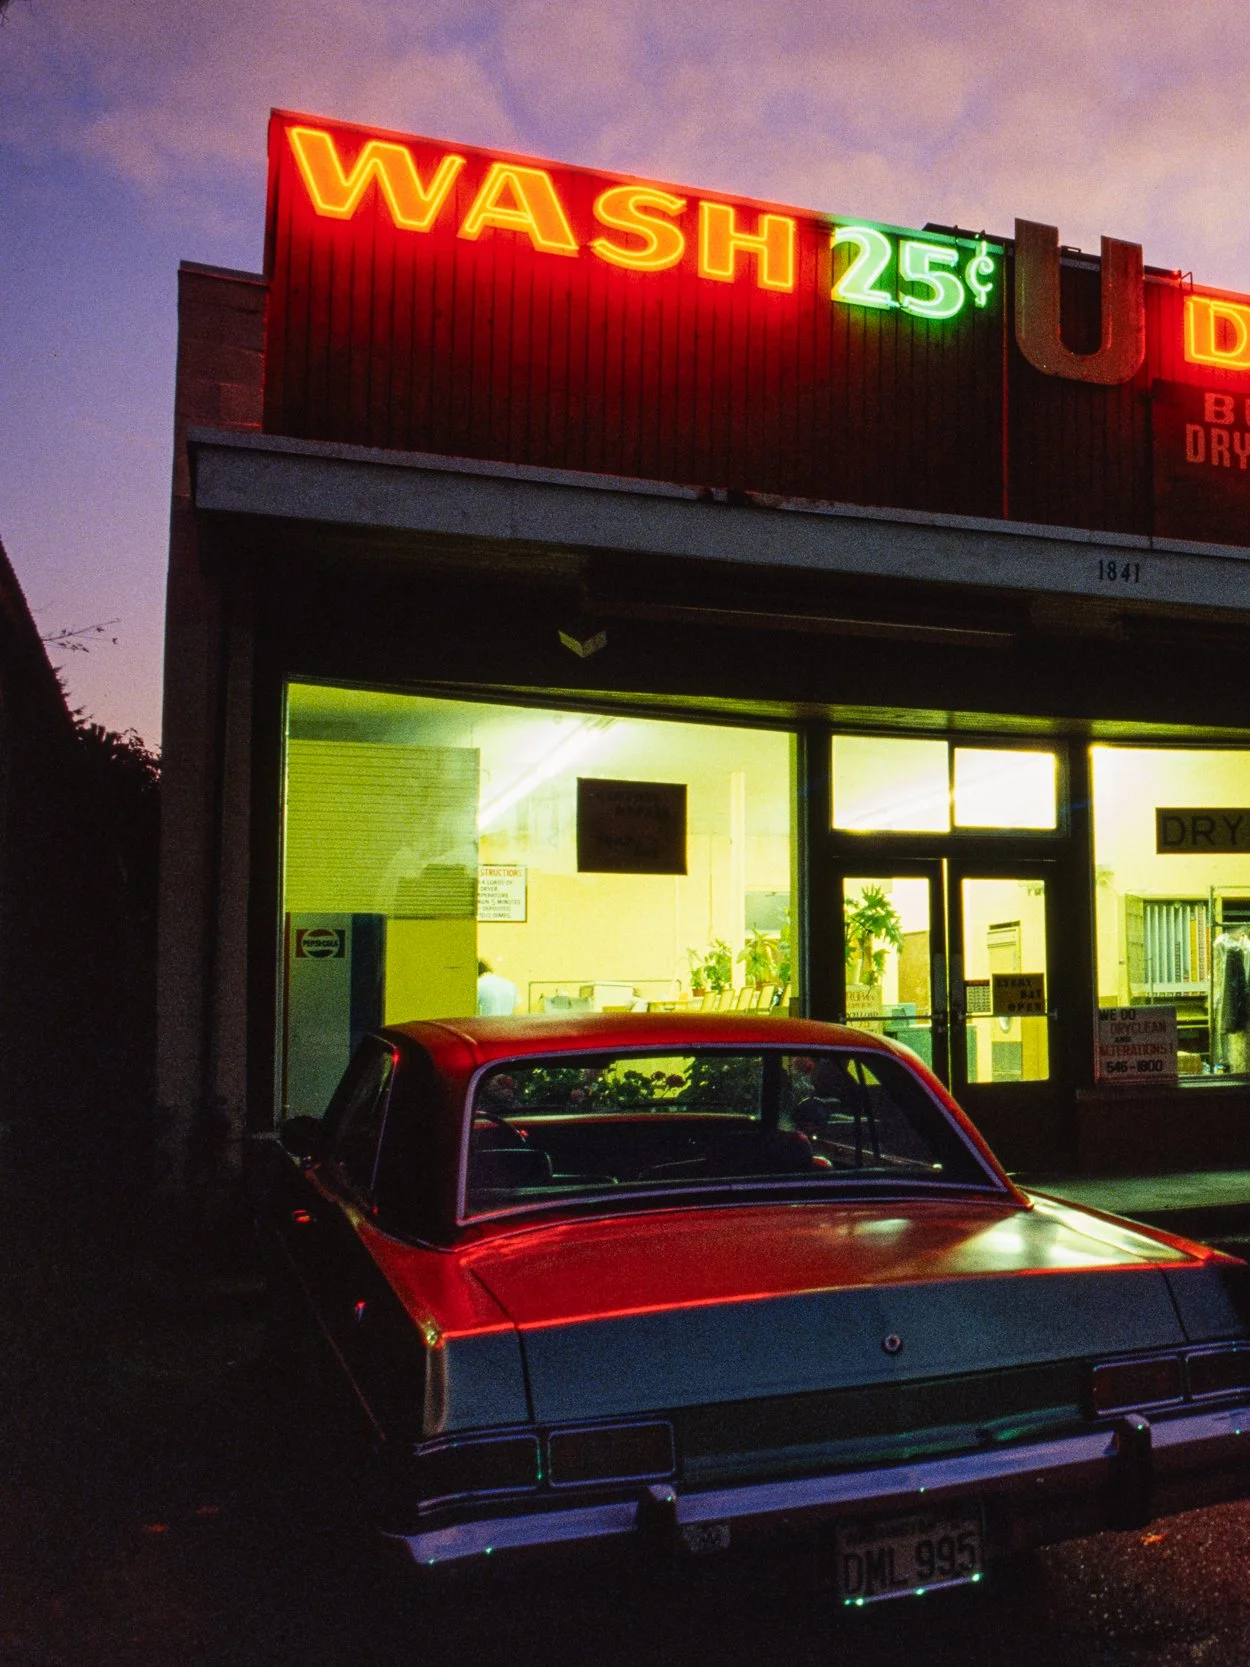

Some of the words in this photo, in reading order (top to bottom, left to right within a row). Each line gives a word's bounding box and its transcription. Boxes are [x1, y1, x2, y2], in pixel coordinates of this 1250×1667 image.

[286, 126, 795, 294] WASH
[830, 226, 995, 320] 25¢
[1014, 218, 1146, 385] U
[1098, 559, 1140, 583] 1841
[1098, 1009, 1117, 1021] WE
[1120, 1008, 1136, 1020] DO
[1110, 1020, 1167, 1034] DRYCLEAN
[844, 1547, 908, 1595] DML
[916, 1531, 978, 1578] 995
